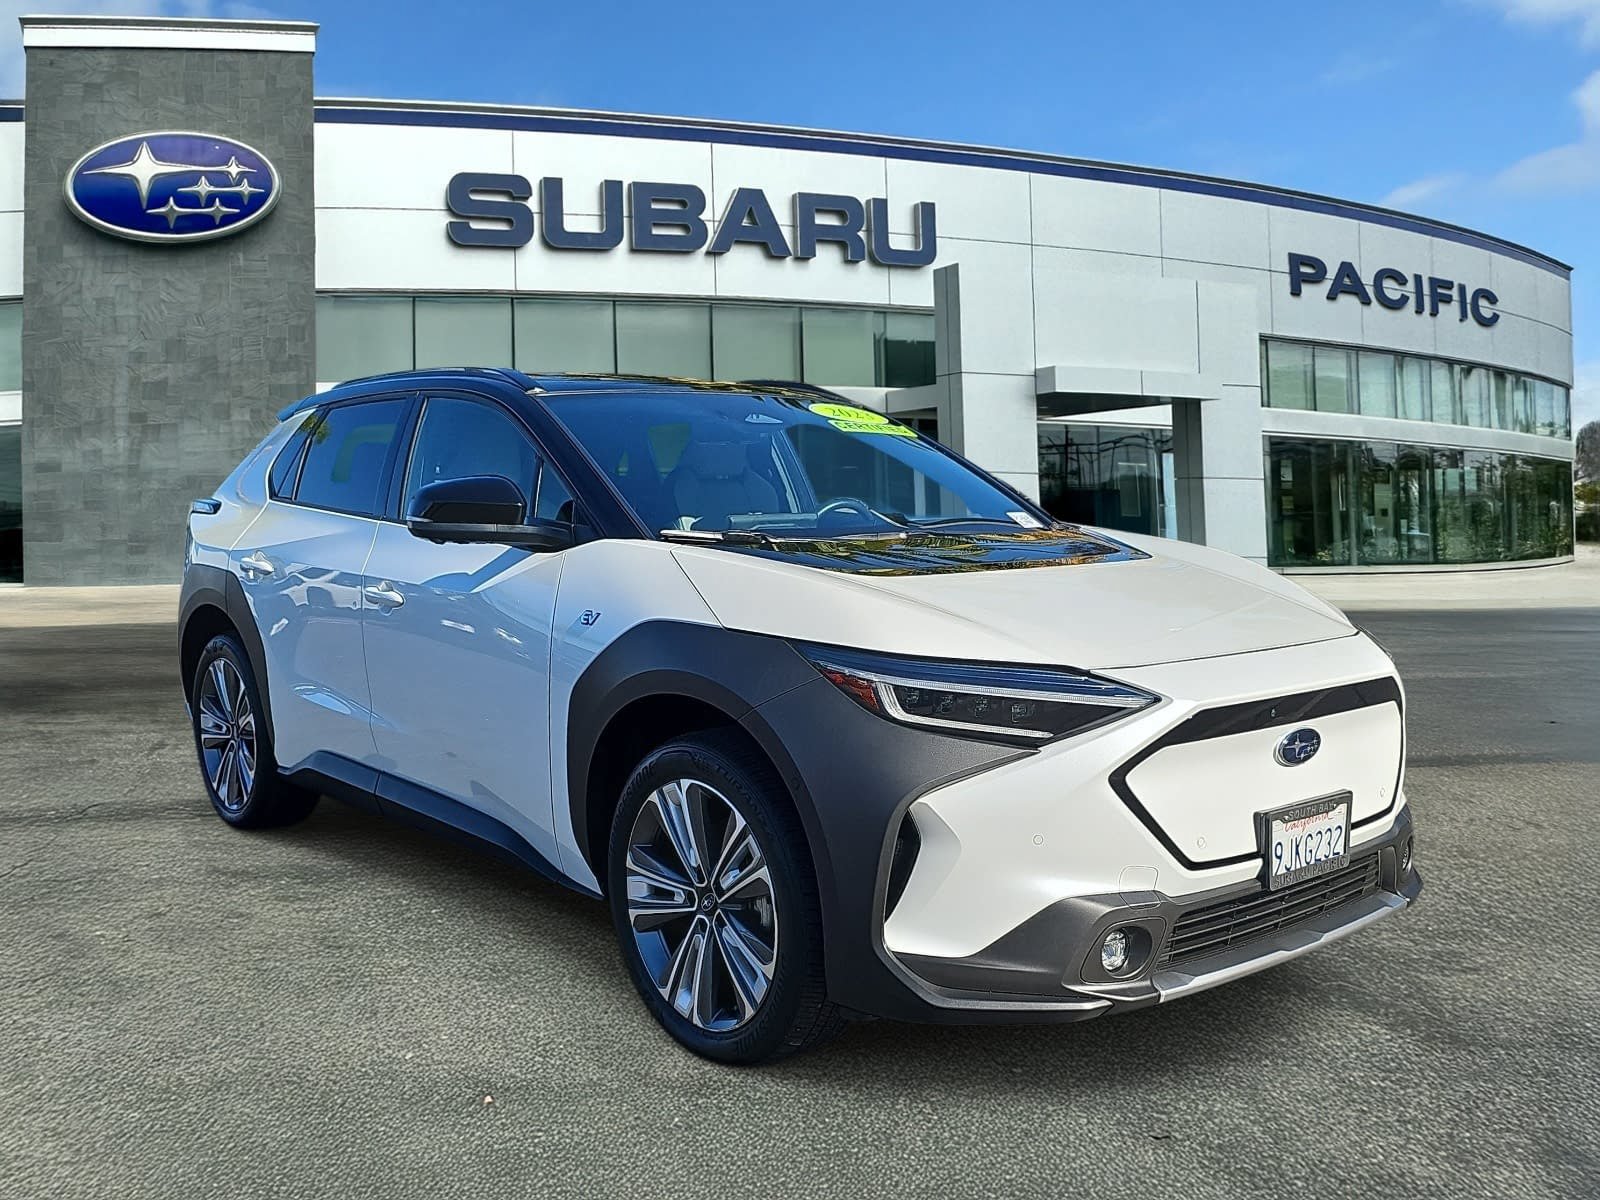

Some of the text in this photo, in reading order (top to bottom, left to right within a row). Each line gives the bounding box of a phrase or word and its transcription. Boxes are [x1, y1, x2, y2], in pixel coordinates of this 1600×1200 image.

[446, 171, 937, 268] SUBARU
[1288, 251, 1500, 328] PACIFIC
[1288, 801, 1334, 820] SOUTH BAY
[1274, 825, 1343, 877] 9JKG232
